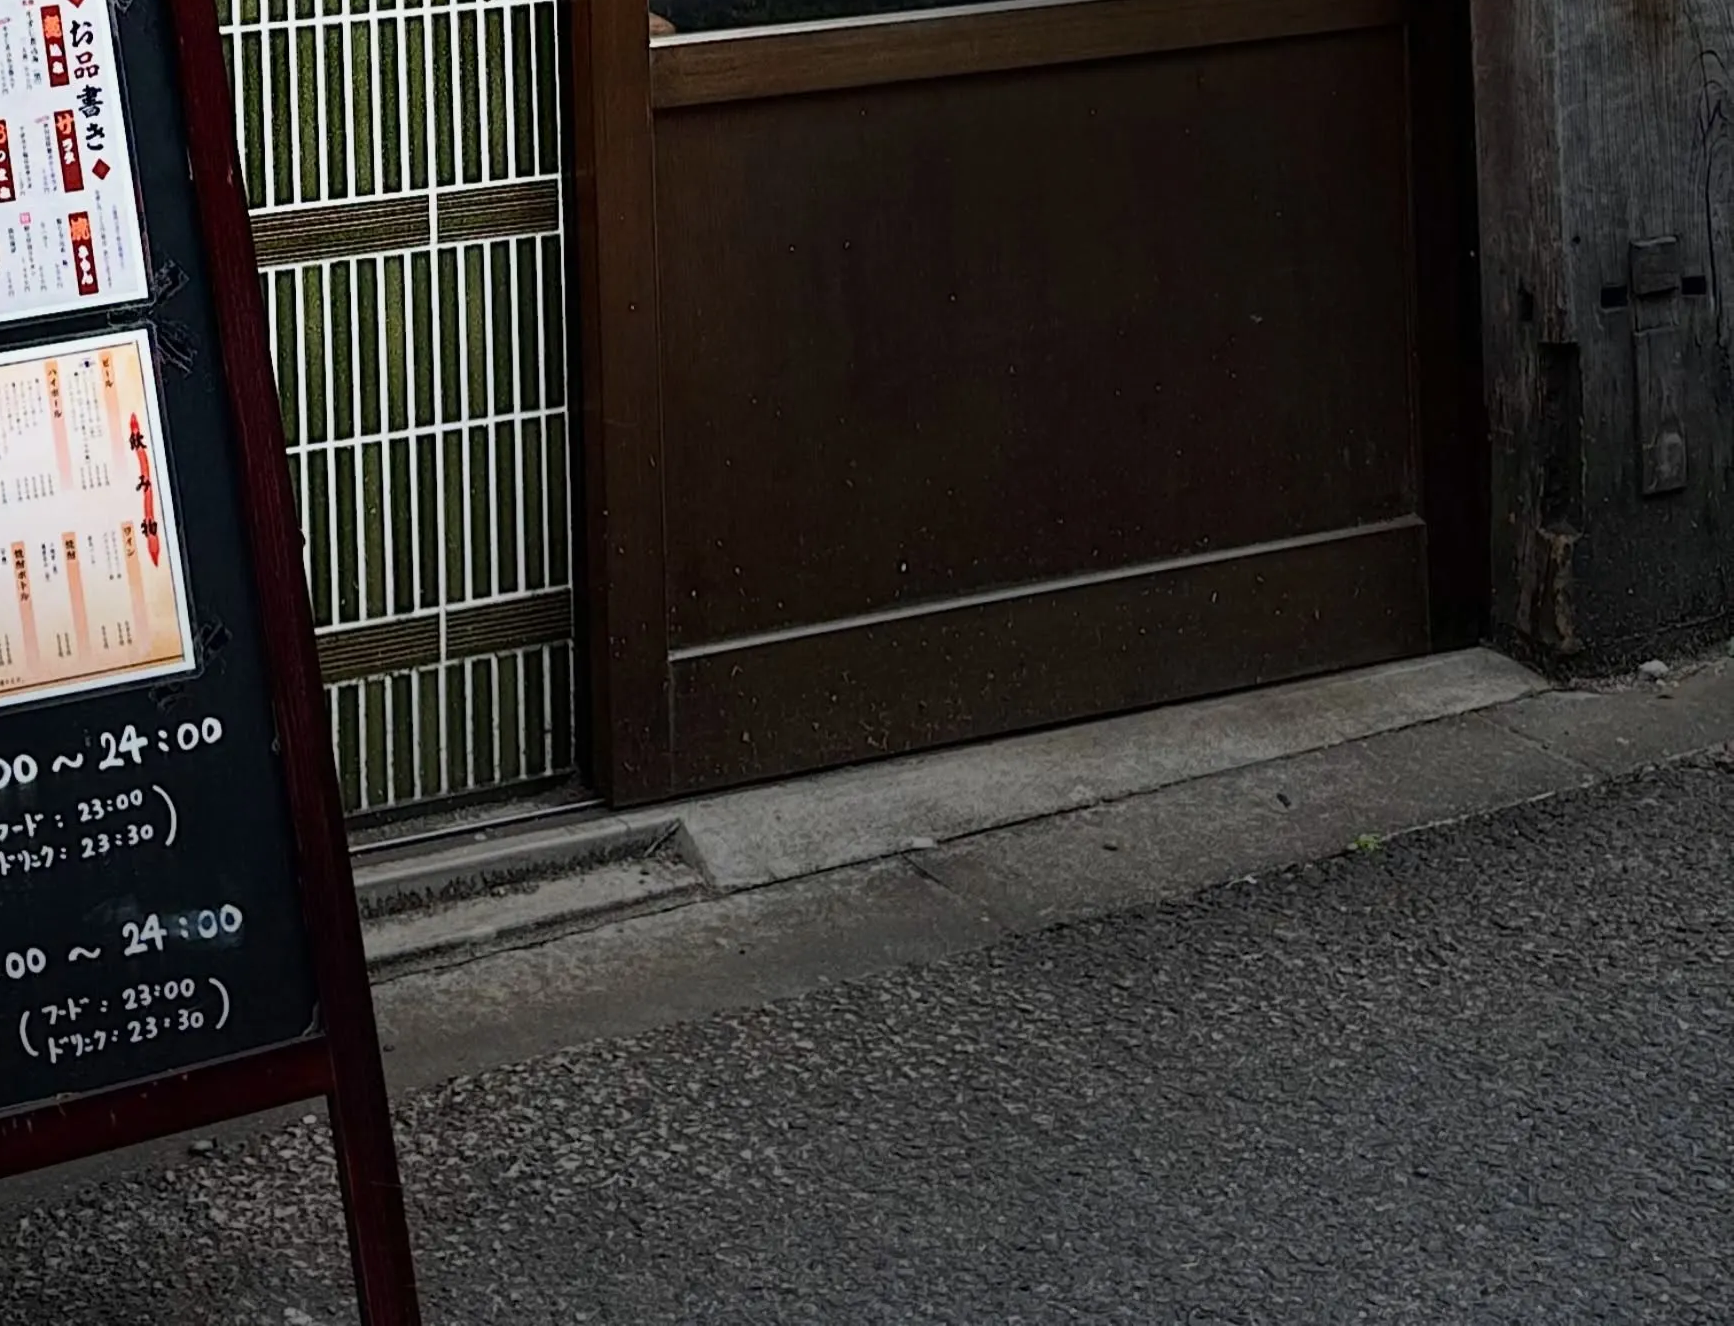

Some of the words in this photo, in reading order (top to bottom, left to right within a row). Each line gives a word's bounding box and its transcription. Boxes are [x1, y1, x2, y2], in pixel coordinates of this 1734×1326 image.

[69, 19, 106, 151] お品書き
[77, 789, 144, 825] 23:00
[80, 822, 155, 860] 23:30
[122, 978, 196, 1013] 23:00
[128, 1009, 205, 1045] 23:30
